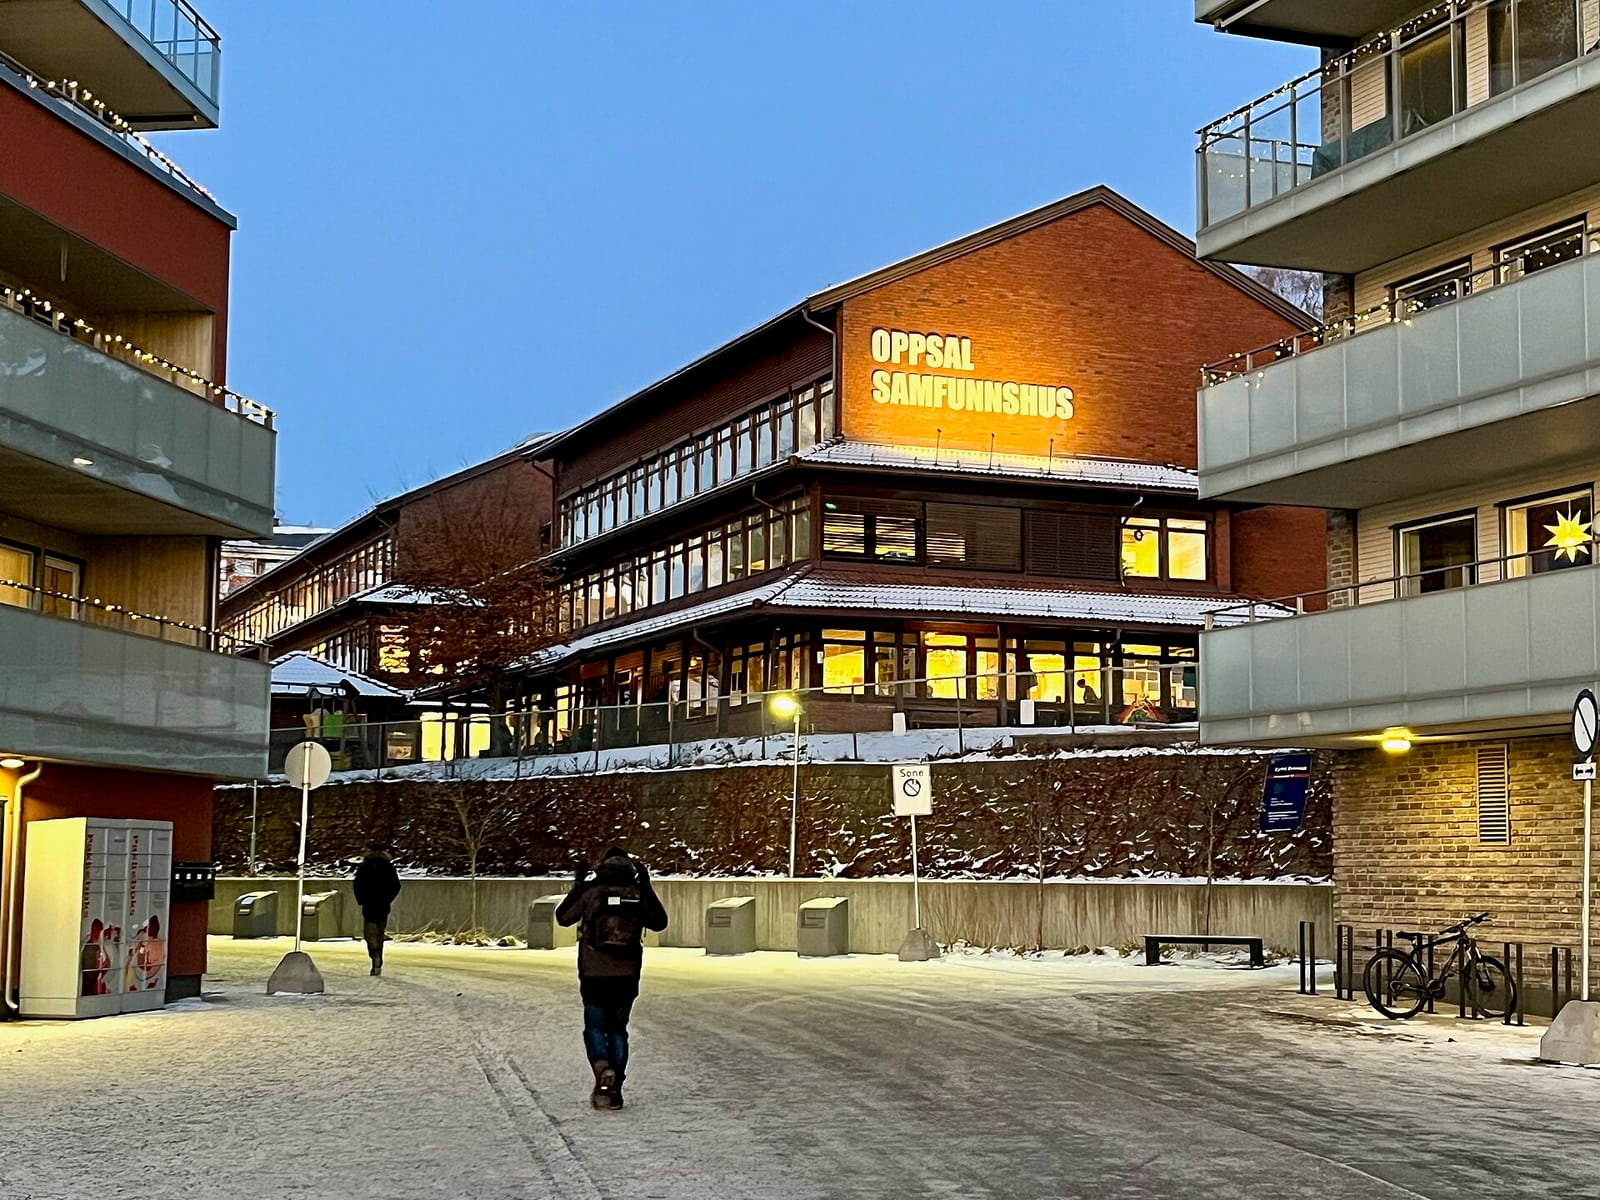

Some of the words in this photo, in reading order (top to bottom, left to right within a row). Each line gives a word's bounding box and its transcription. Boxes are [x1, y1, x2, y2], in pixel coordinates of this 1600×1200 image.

[871, 328, 975, 371] OPPSAL
[871, 369, 1074, 420] SAMFUNNSHUS
[899, 768, 924, 778] Sone
